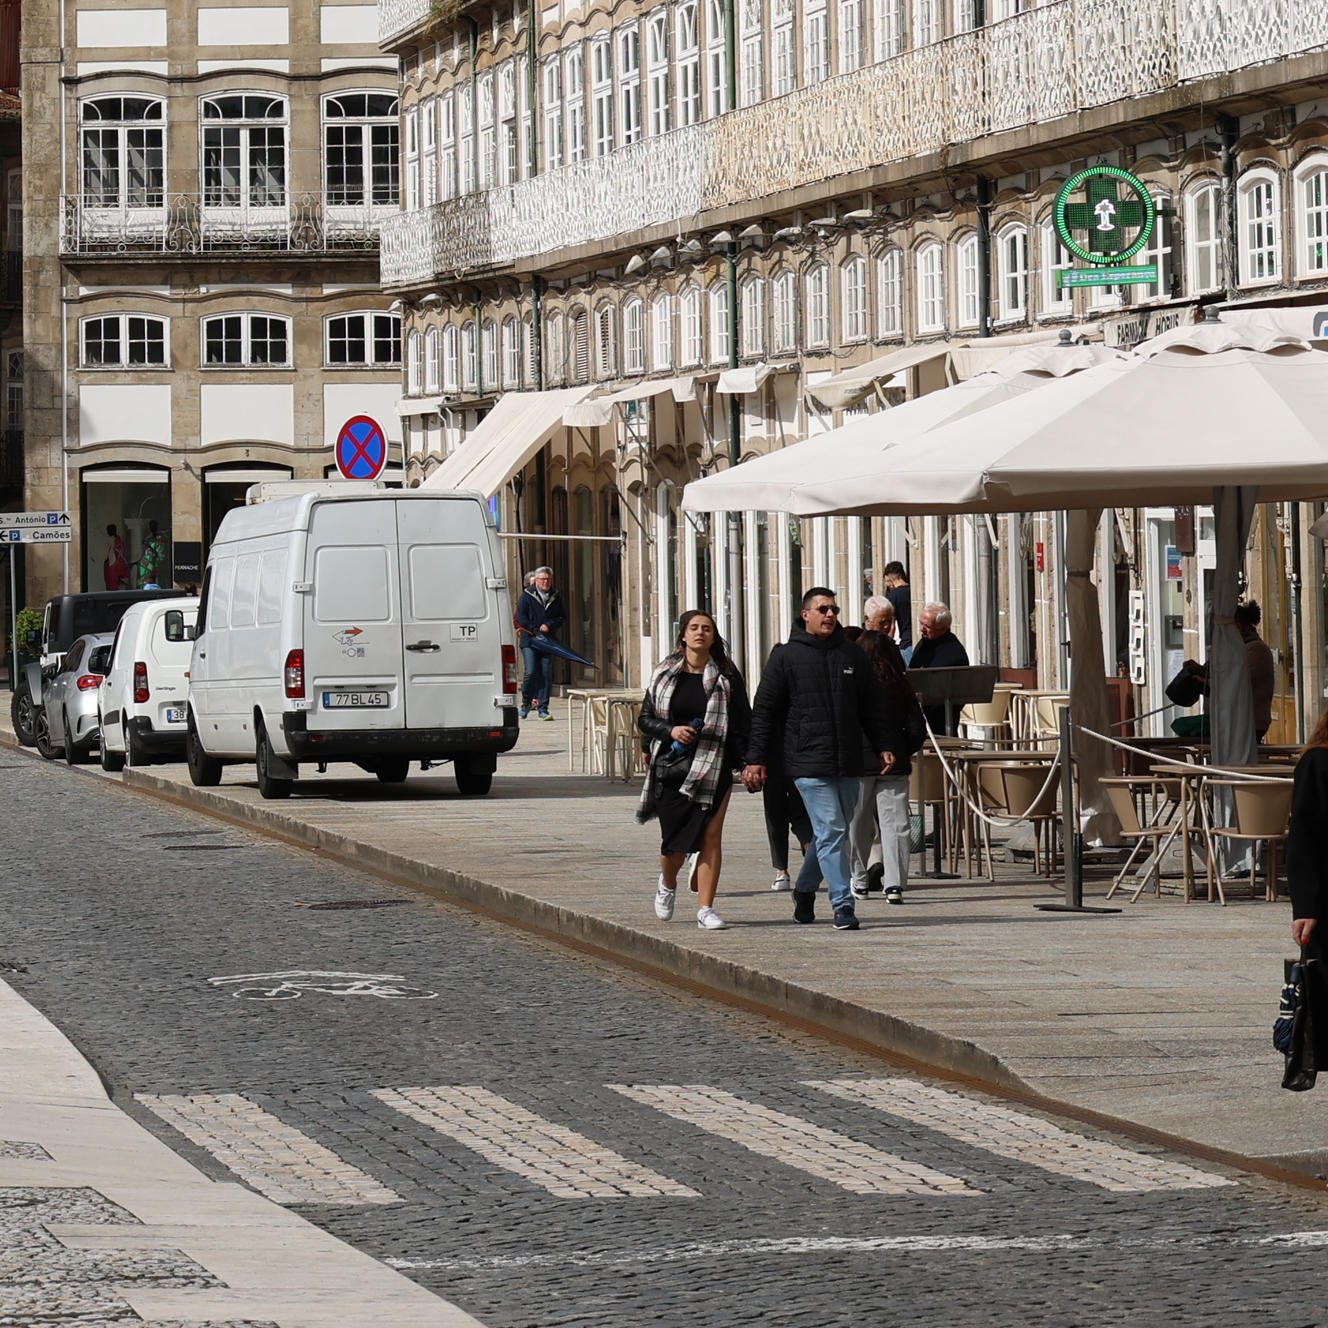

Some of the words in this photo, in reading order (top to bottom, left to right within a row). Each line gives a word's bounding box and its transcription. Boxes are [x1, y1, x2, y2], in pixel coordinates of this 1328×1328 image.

[15, 516, 46, 524] António
[33, 531, 70, 540] Camões
[459, 626, 476, 637] TP
[368, 694, 381, 705] 45
[174, 710, 185, 719] 38
